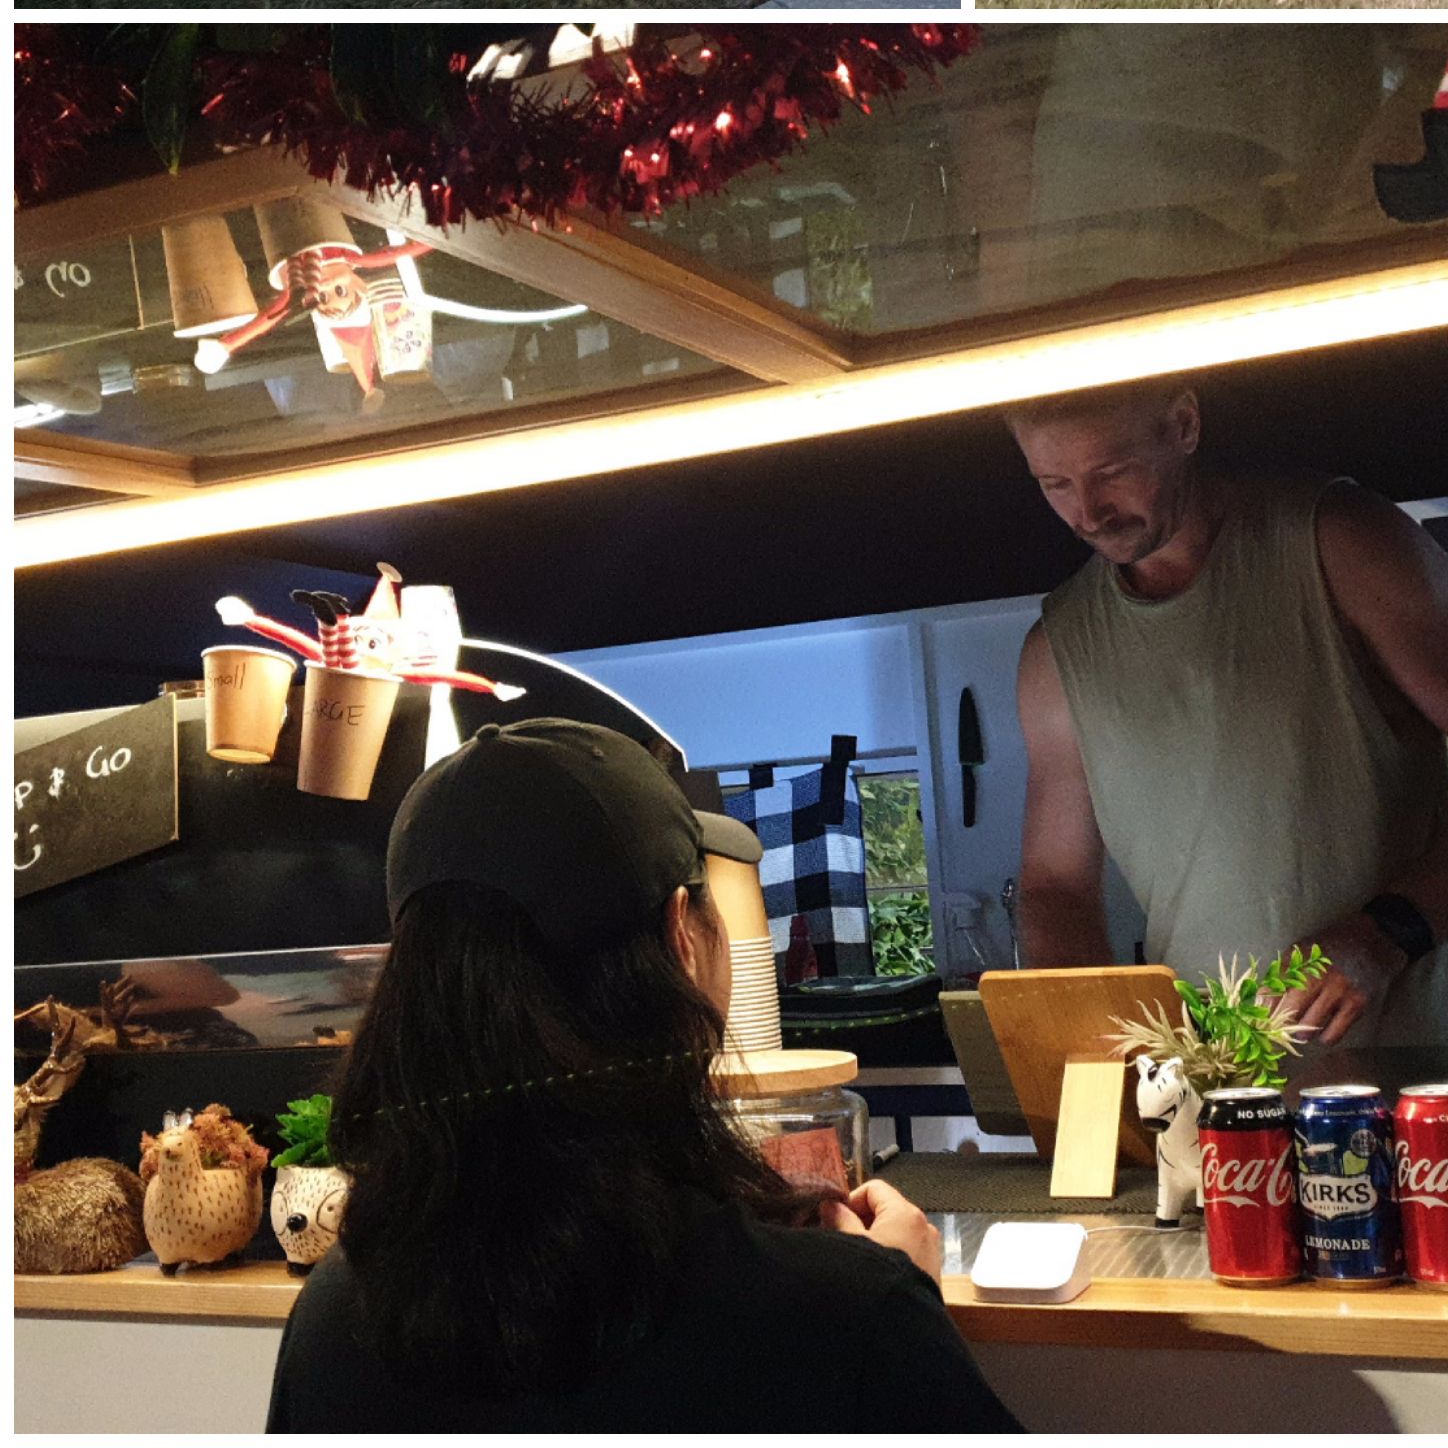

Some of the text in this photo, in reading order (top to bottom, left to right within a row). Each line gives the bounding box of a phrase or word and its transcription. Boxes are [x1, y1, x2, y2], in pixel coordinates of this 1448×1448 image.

[86, 745, 132, 779] GO
[1237, 1109, 1254, 1119] NO
[1301, 1182, 1371, 1204] KIRKS
[1305, 1235, 1371, 1250] LEMONADE
